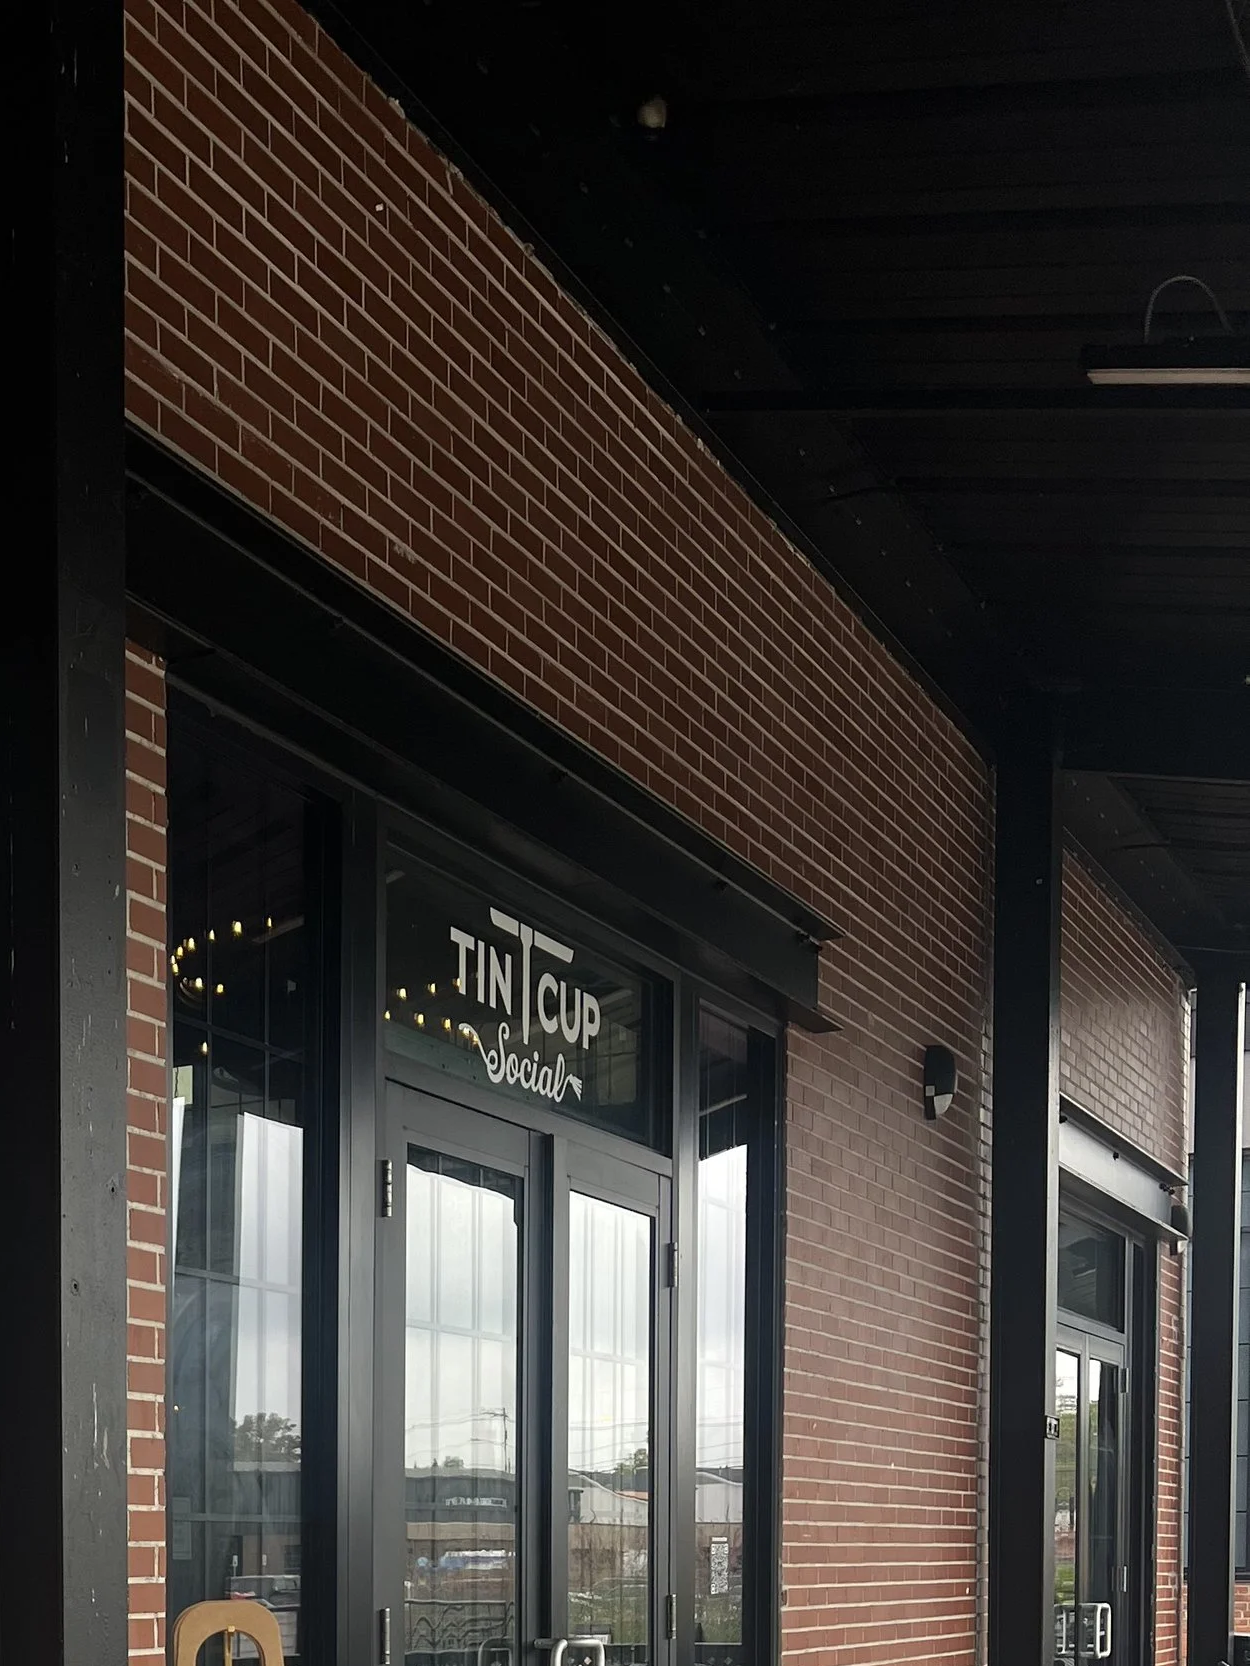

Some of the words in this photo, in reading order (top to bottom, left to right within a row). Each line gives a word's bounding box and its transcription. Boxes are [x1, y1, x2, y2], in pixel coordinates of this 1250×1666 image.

[450, 926, 512, 1016] TIN
[537, 972, 601, 1050] CUP
[458, 1022, 580, 1103] Social
